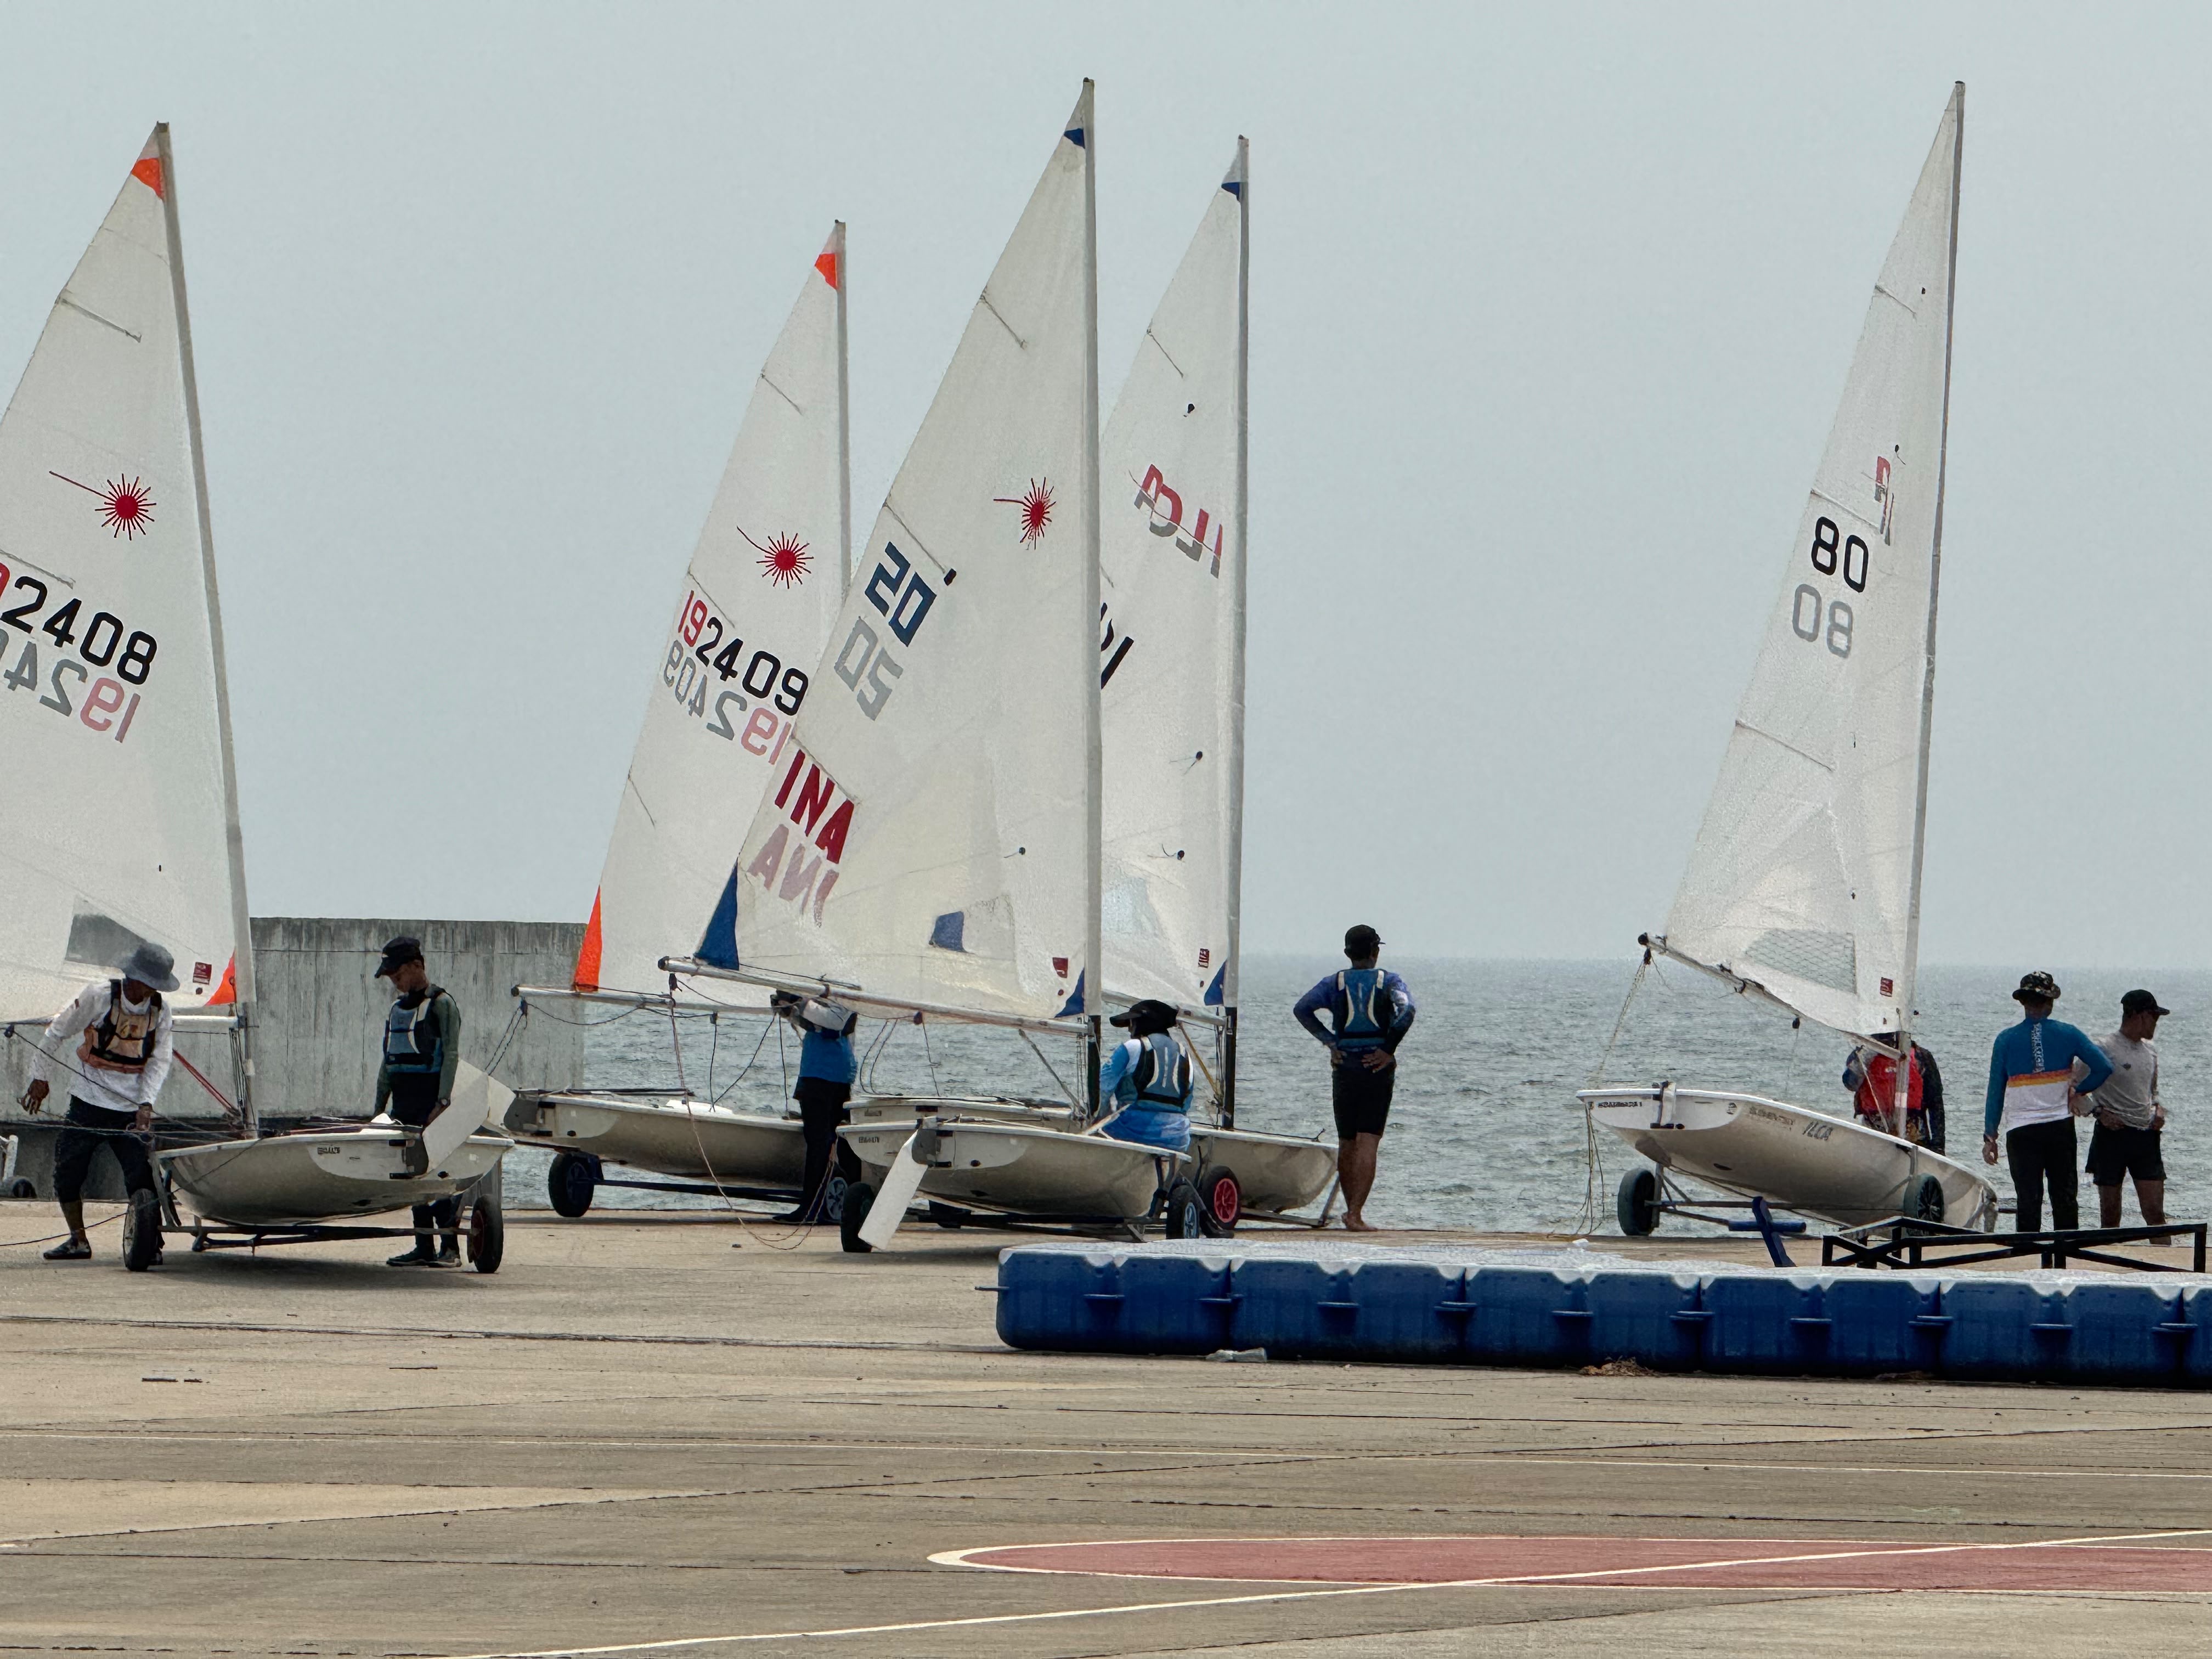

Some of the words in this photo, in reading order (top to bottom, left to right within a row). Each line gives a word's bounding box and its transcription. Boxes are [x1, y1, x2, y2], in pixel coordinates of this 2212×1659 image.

[865, 541, 937, 647] 20
[1811, 516, 1869, 592] 80
[678, 590, 809, 715] 192409
[774, 749, 854, 864] INA
